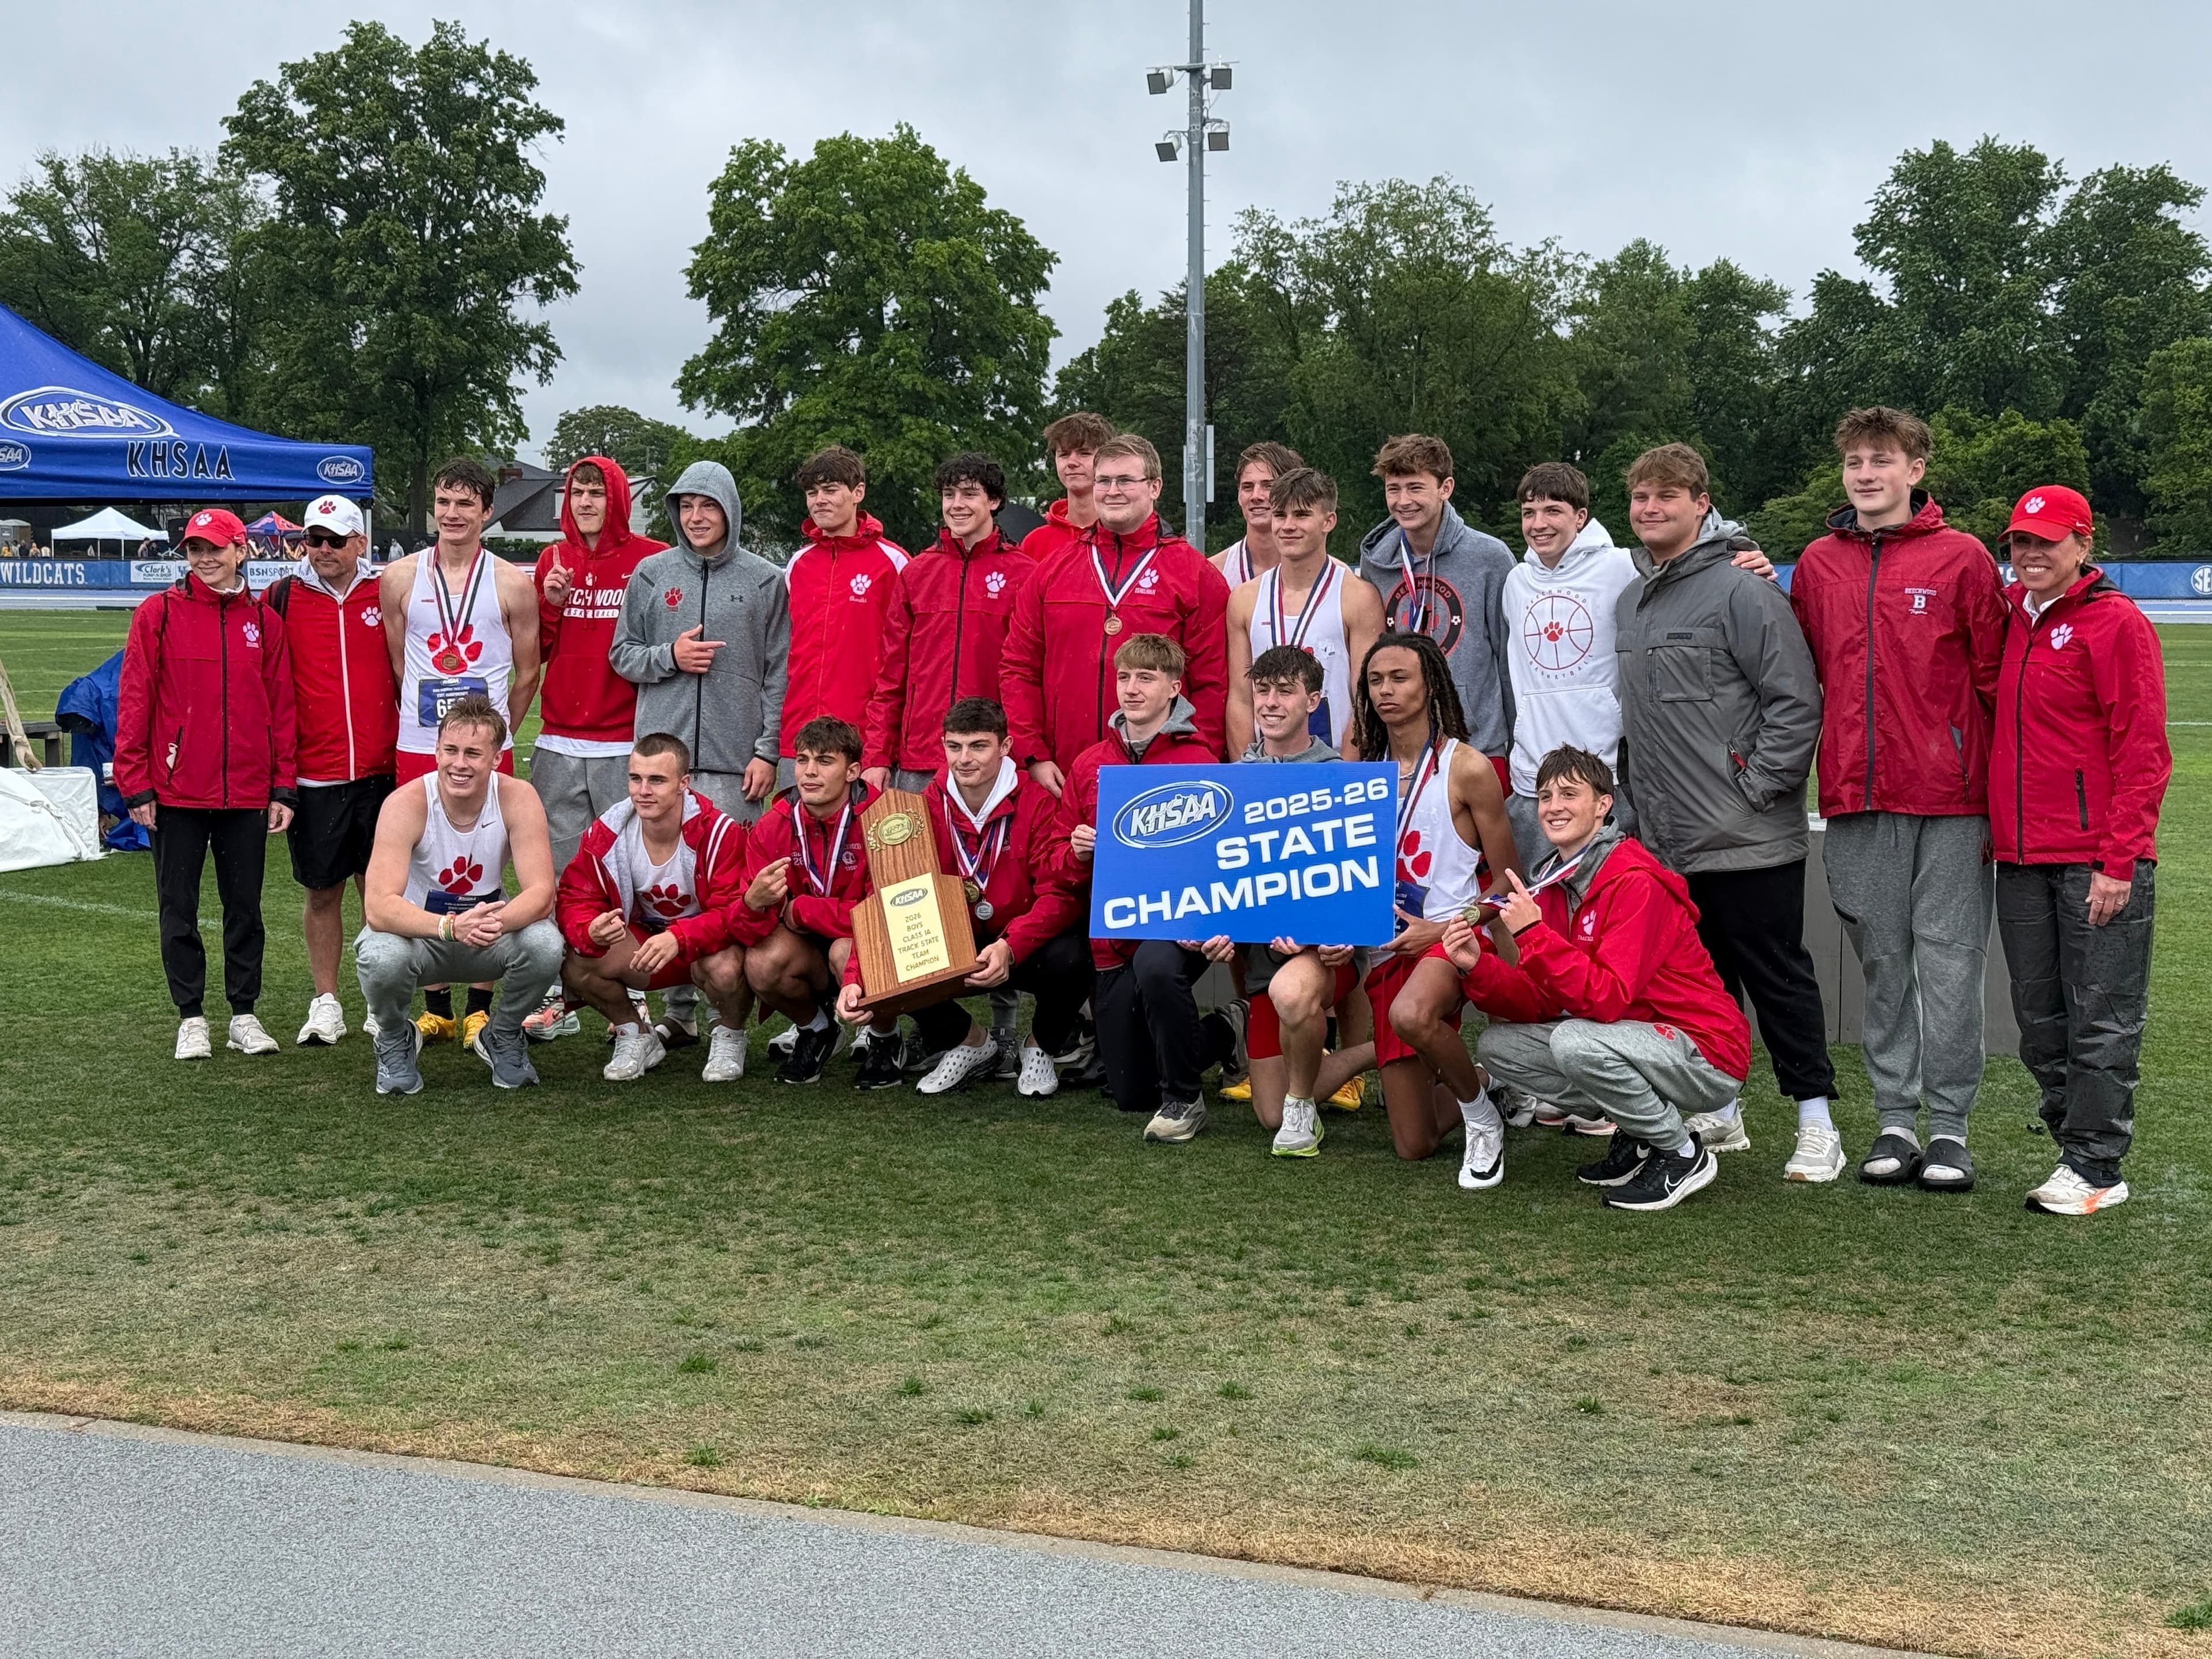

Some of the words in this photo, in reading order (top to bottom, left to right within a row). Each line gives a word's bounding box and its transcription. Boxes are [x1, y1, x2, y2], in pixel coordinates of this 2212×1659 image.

[20, 399, 153, 430] KHSAA
[0, 446, 22, 463] SAA
[127, 440, 236, 480] KHSAA
[324, 462, 358, 477] KHSAA
[0, 562, 85, 585] WILDCATS
[144, 565, 172, 573] Clark's
[2194, 567, 2212, 593] SE
[1526, 589, 1587, 610] BEECHWOOD
[1912, 594, 1926, 608] B
[436, 697, 467, 719] 65
[1244, 777, 1389, 824] 2025-26
[1130, 790, 1217, 837] KHSAA
[1215, 813, 1376, 870] STATE
[895, 889, 924, 905] KHSAA
[1103, 855, 1380, 930] CHAMPION
[905, 912, 922, 923] 2026
[907, 922, 923, 931] BOYS
[898, 942, 919, 954] TRACK
[921, 935, 939, 947] STATE
[903, 931, 923, 942] CLASS
[906, 955, 939, 972] CHAMPION
[912, 949, 929, 959] TEAM
